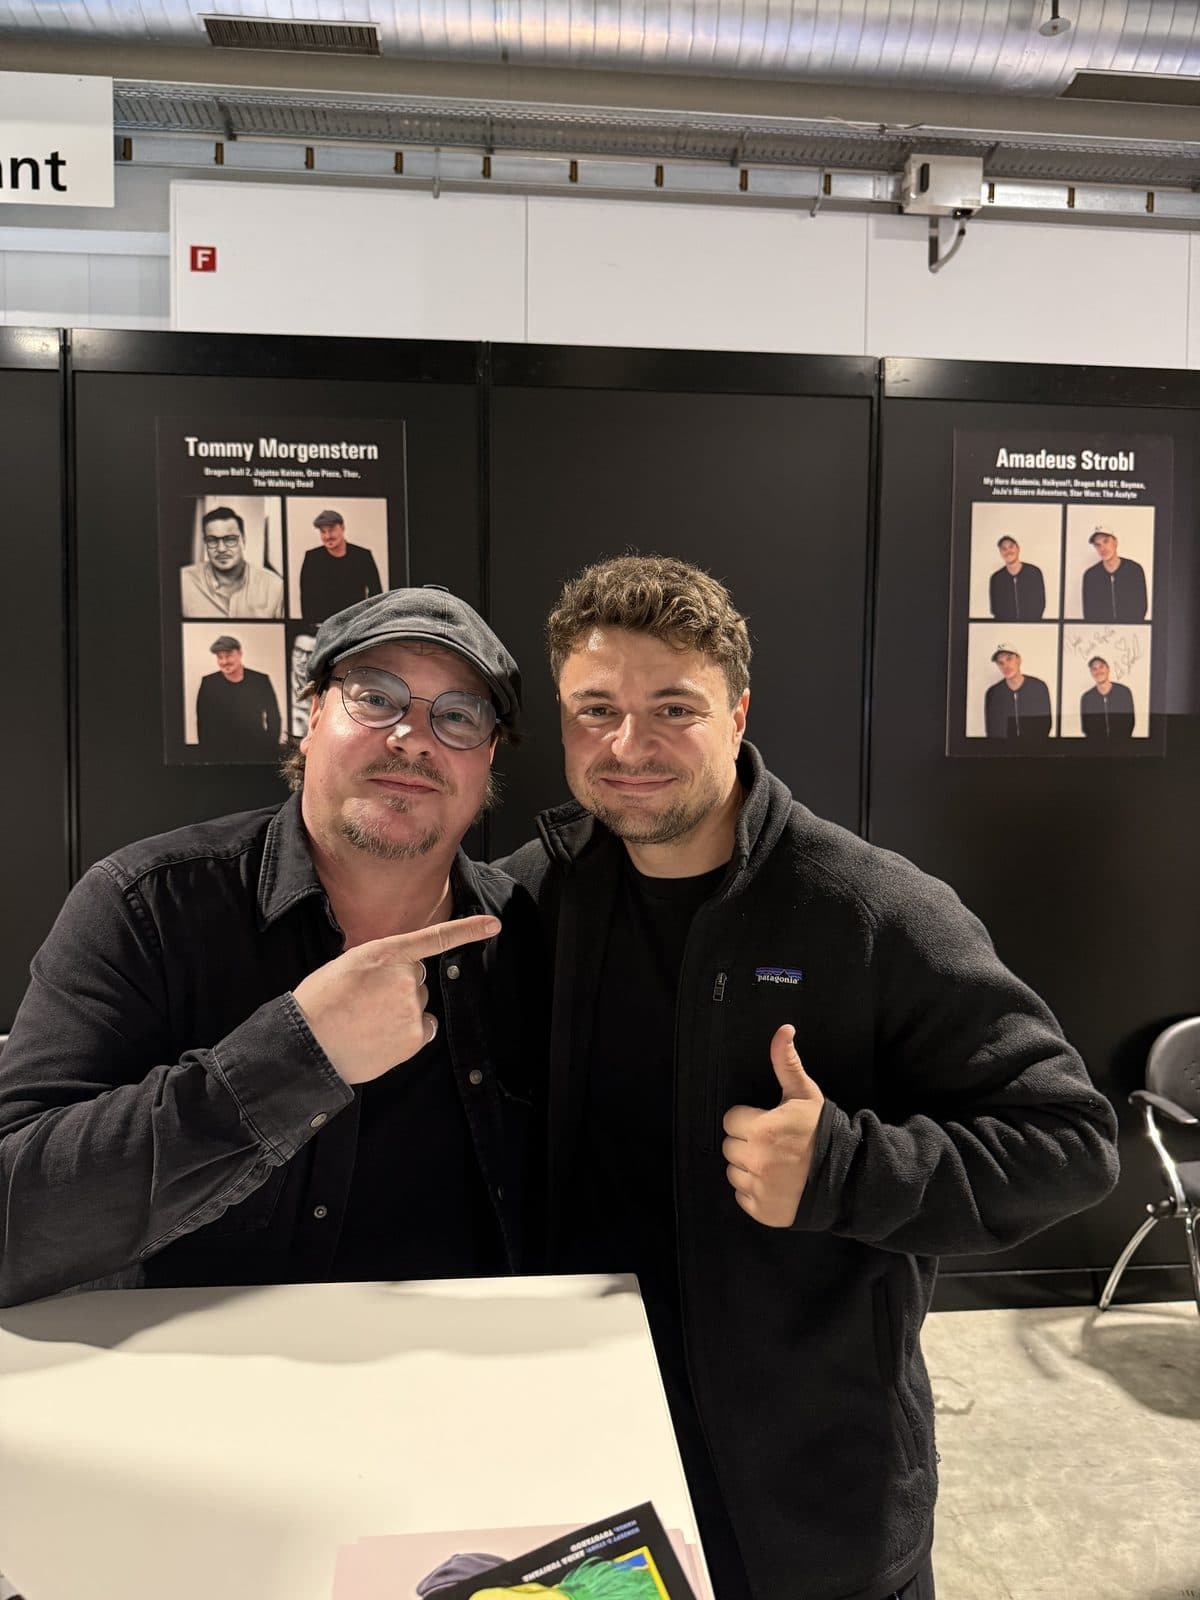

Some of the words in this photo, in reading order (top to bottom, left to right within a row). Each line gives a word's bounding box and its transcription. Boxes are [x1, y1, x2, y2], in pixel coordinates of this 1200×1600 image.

[0, 151, 67, 192] nt
[196, 249, 213, 269] F
[184, 436, 254, 462] Tommy
[258, 437, 379, 463] Morgenstern
[996, 447, 1077, 470] Amadeus
[1080, 450, 1135, 472] Strobl
[204, 467, 230, 477] Dragon
[230, 467, 245, 476] Ball
[305, 469, 320, 477] One
[253, 479, 266, 487] The
[267, 479, 295, 489] Walking
[296, 479, 314, 488] Dead
[983, 477, 993, 486] My
[994, 477, 1009, 485] Hero
[1073, 479, 1095, 488] Dragon
[1069, 489, 1083, 497] Star
[1102, 489, 1114, 498] The
[757, 974, 799, 984] patagonia
